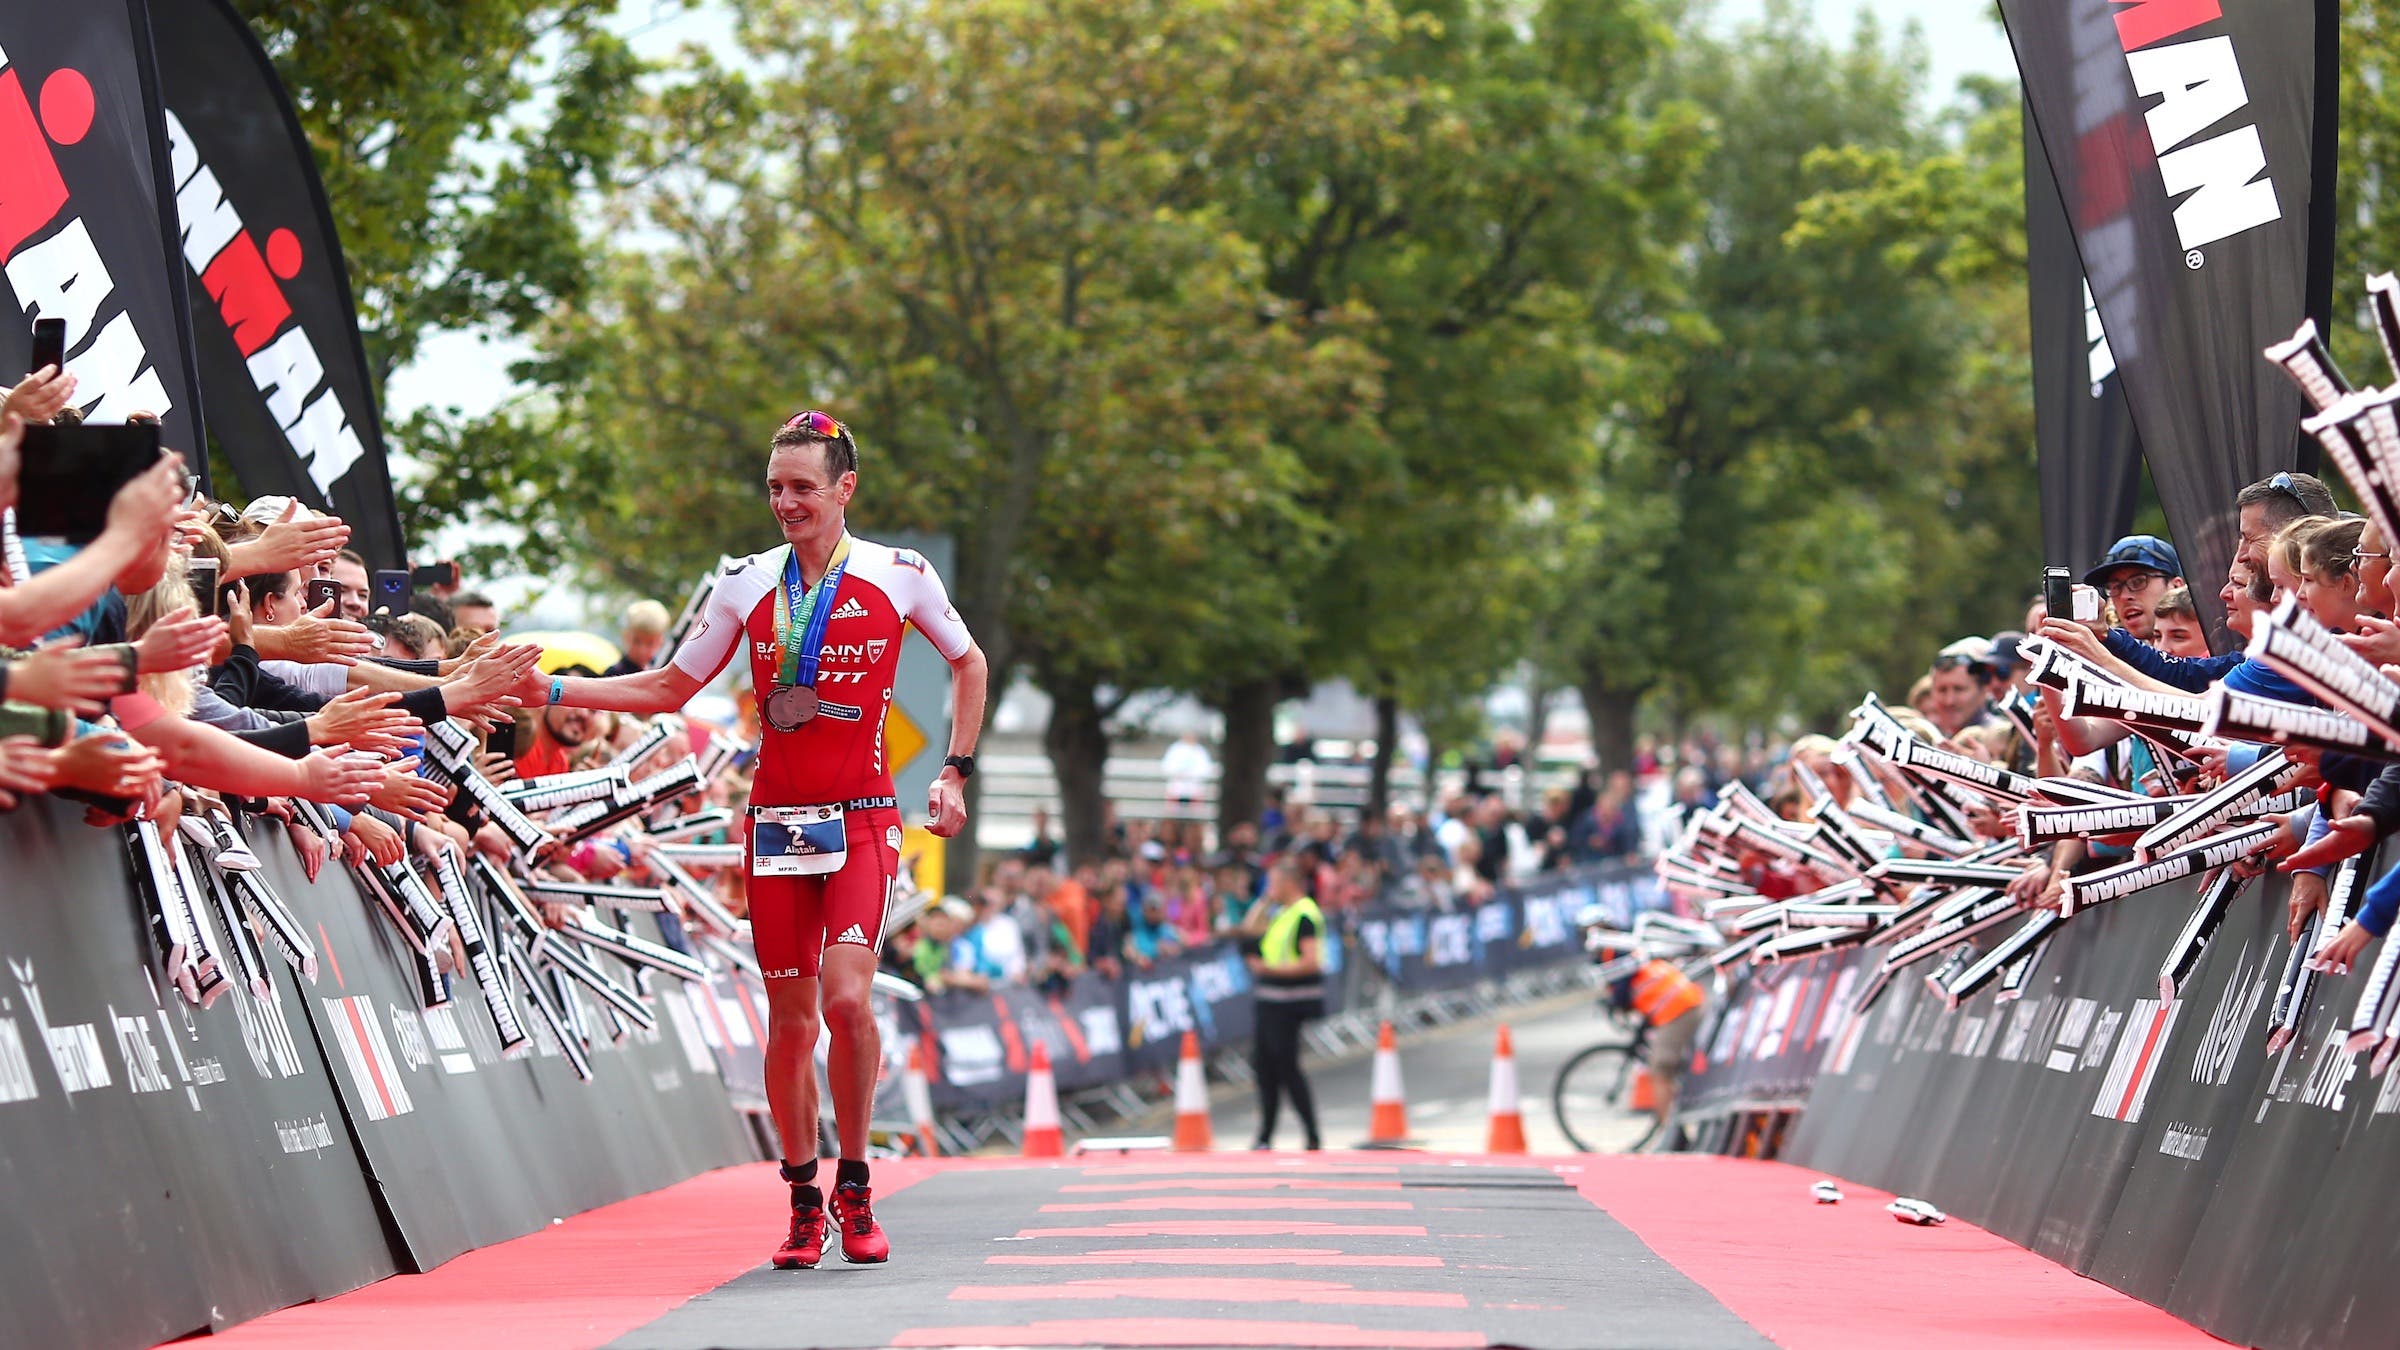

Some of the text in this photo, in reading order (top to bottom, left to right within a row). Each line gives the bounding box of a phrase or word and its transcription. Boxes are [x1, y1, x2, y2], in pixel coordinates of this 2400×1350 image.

[2113, 0, 2282, 251] AN
[0, 42, 173, 424] MAN
[830, 608, 869, 620] adidas
[756, 642, 864, 656] BAAIN
[789, 623, 807, 654] IRELAND
[2227, 697, 2369, 747] IRONMAN
[1911, 745, 2000, 787] IRONMAN
[464, 772, 543, 847] IRONMAN
[523, 779, 612, 812] IRONMAN
[850, 796, 894, 810] HUUB
[787, 825, 806, 847] 2
[2034, 804, 2157, 836] IRONMAN
[2080, 854, 2191, 905] IRONMAN
[234, 878, 303, 972] IRONMAN
[837, 934, 869, 946] adidas
[762, 967, 799, 979] HUUB
[472, 951, 525, 1043] IRONMAN
